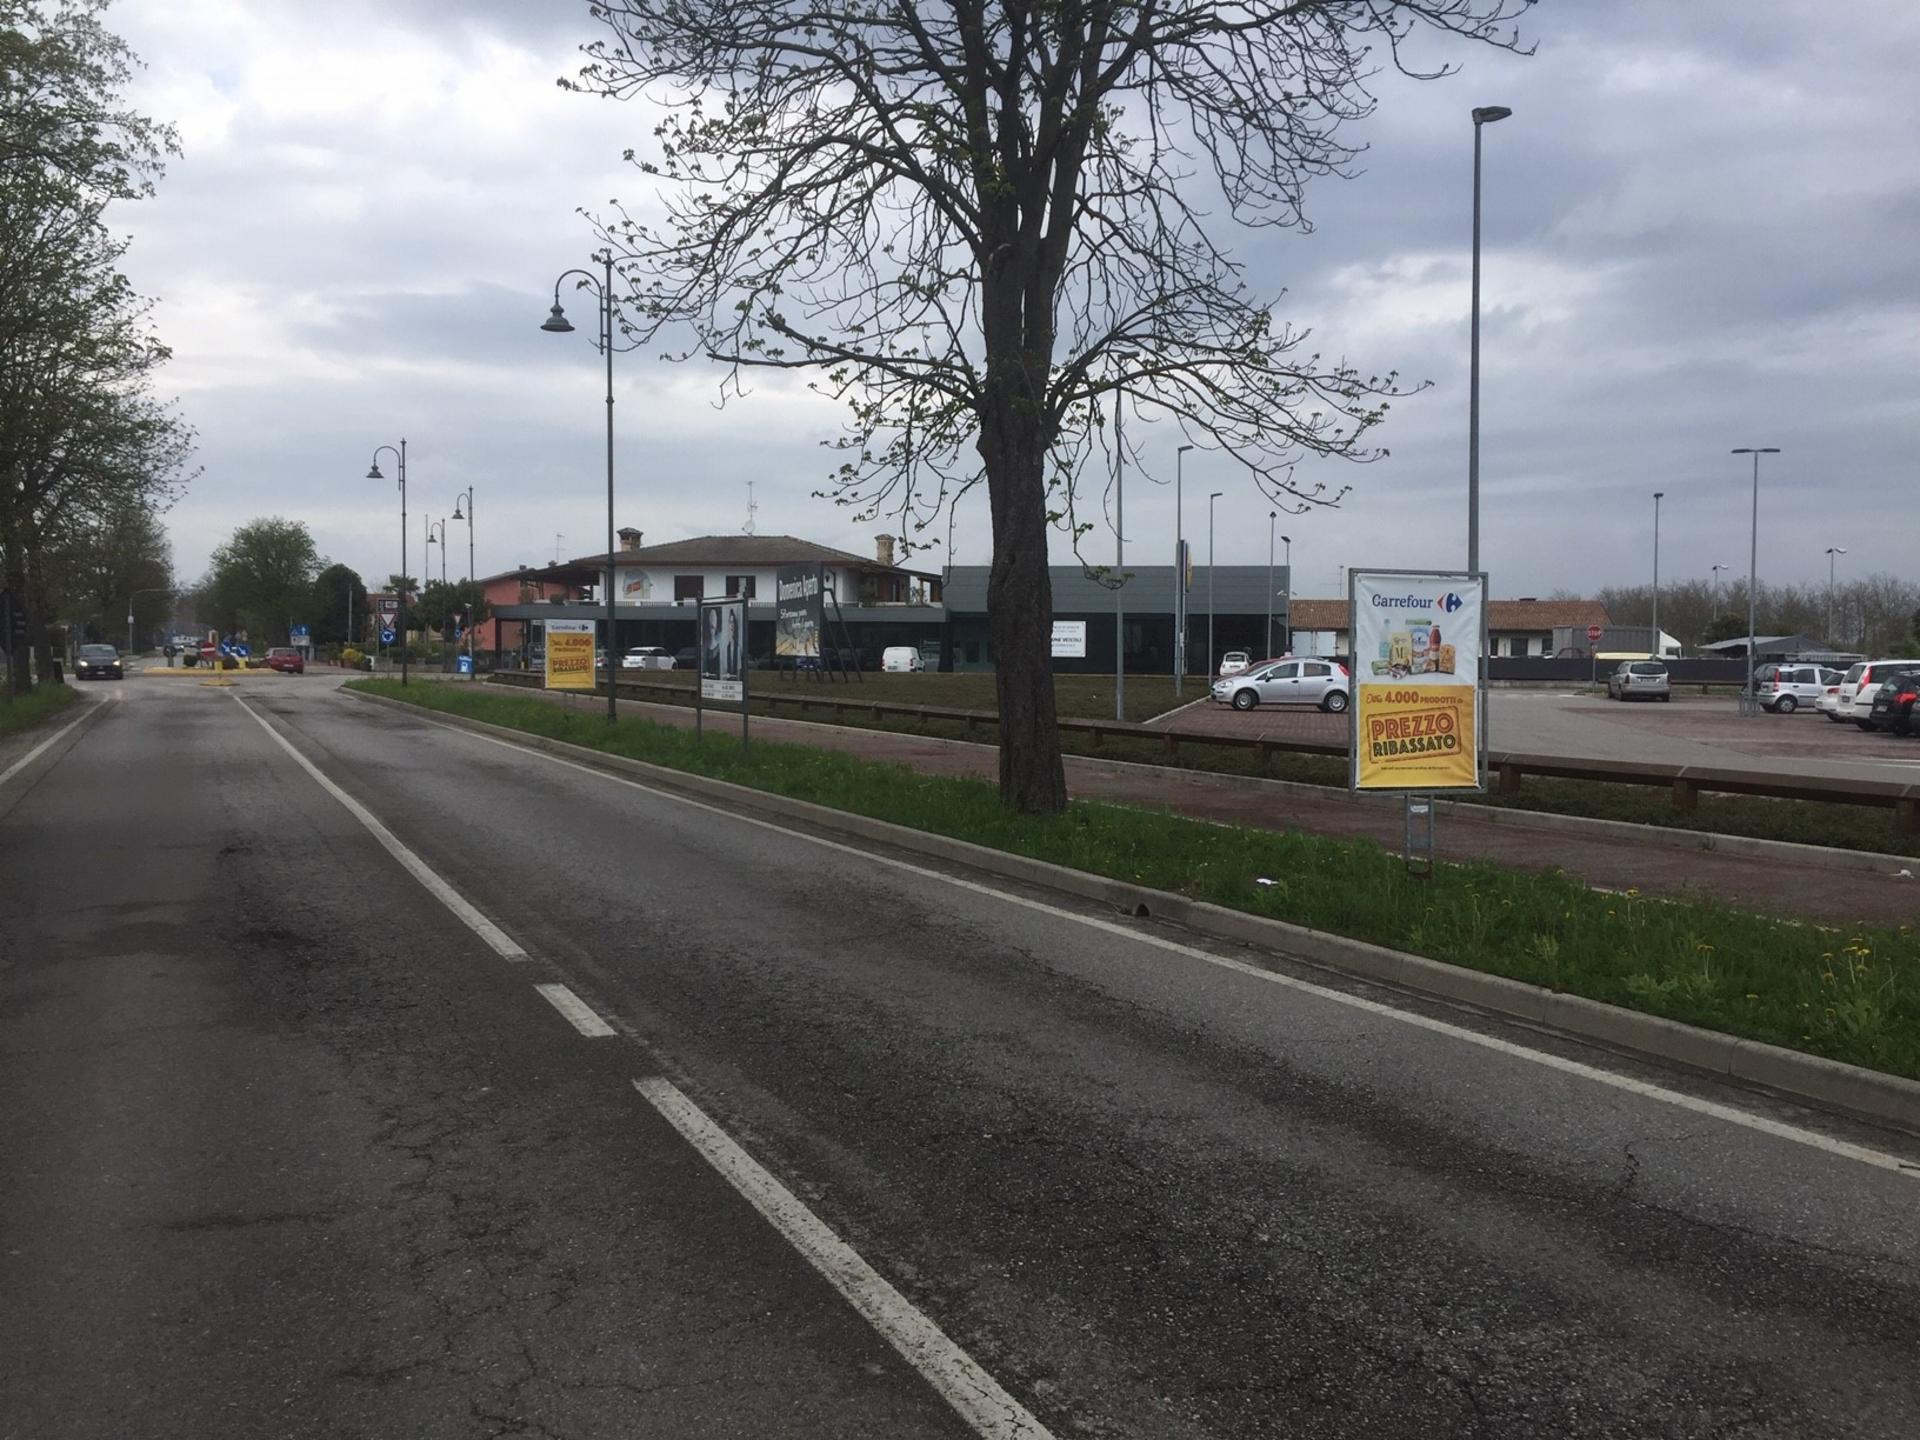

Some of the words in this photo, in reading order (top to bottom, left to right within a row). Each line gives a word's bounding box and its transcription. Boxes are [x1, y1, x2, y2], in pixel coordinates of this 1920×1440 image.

[1372, 593, 1433, 608] Carrefour
[1385, 691, 1419, 703] 4.000
[1371, 712, 1454, 740] PREZZO
[1373, 734, 1456, 757] RIBASSATO
